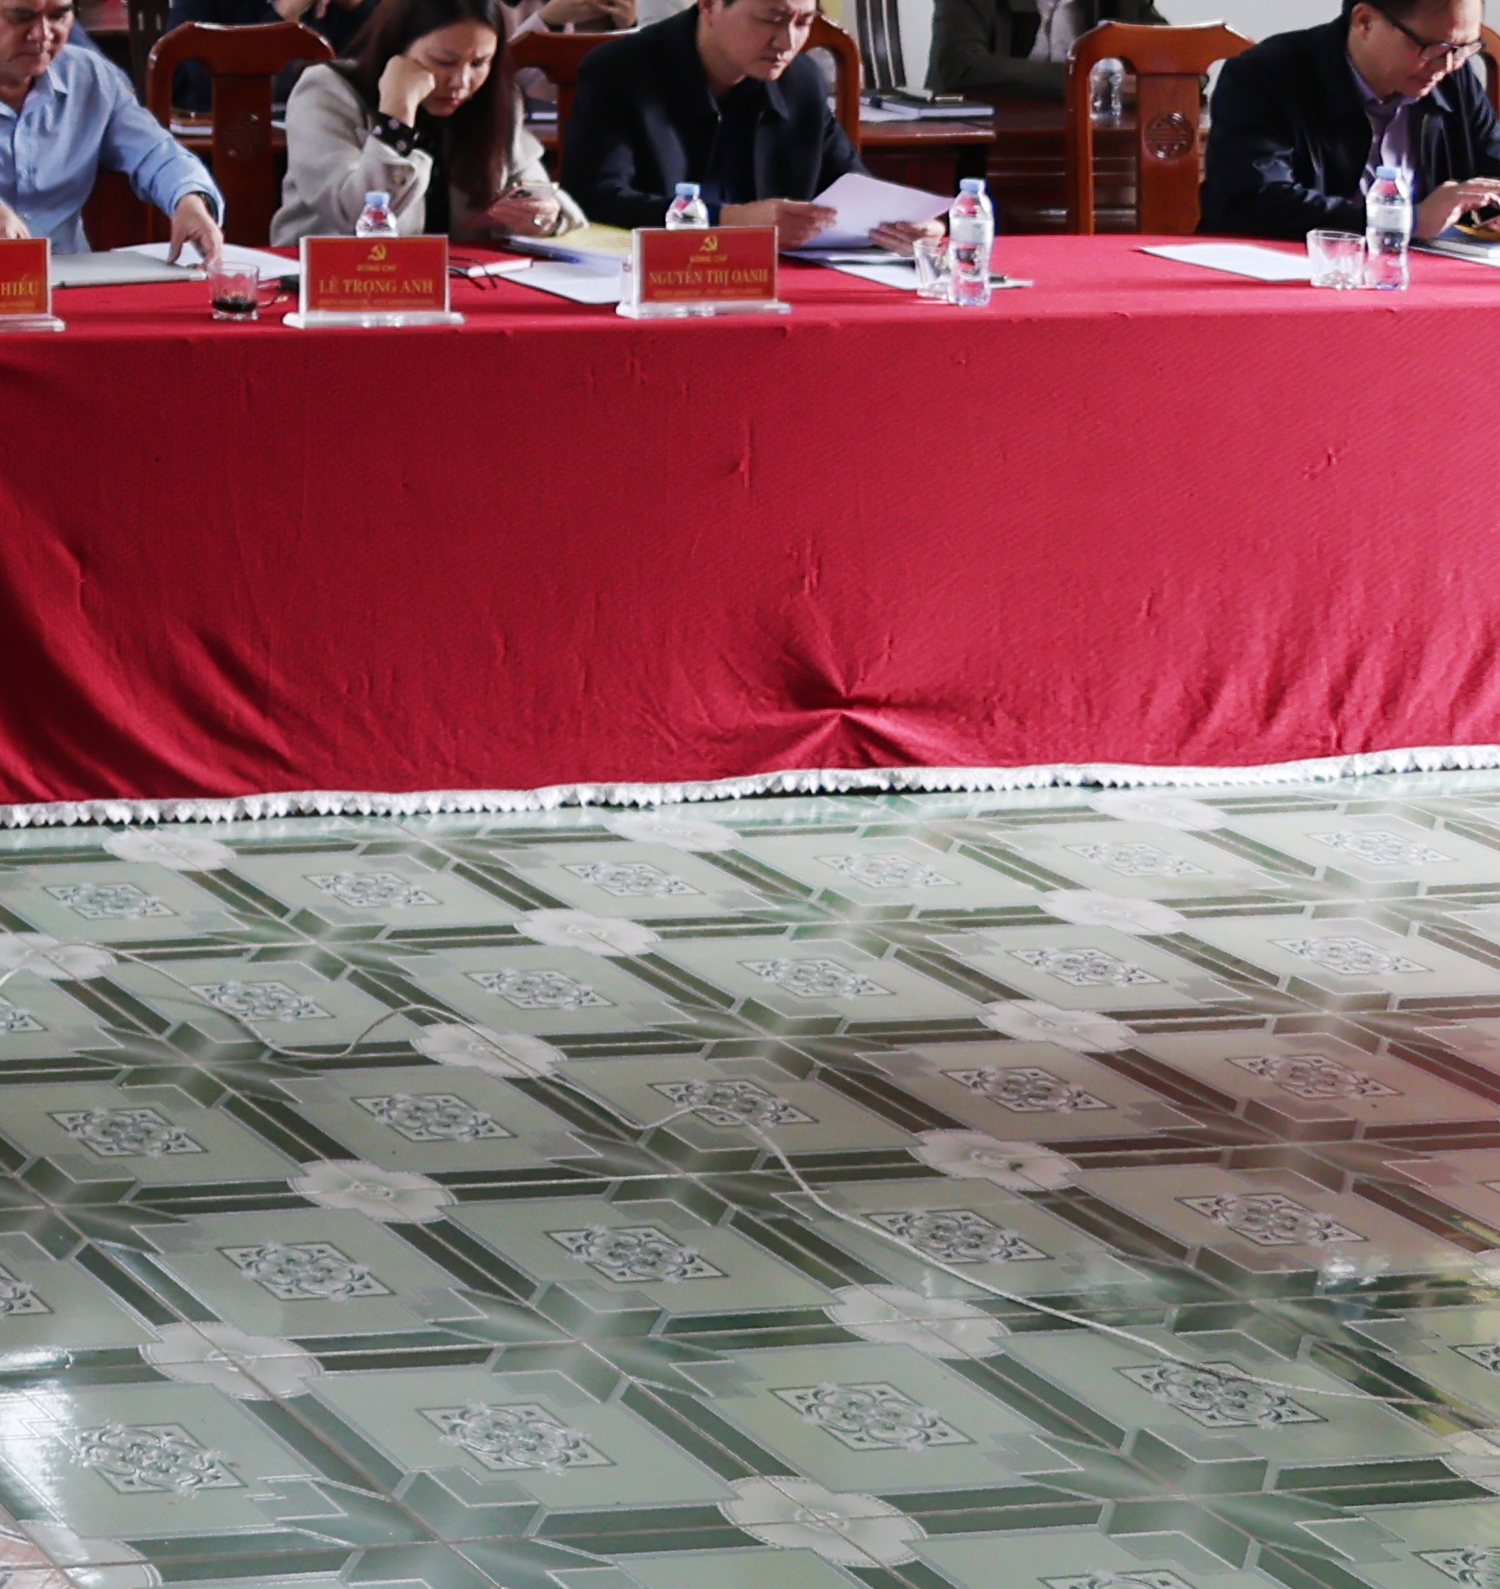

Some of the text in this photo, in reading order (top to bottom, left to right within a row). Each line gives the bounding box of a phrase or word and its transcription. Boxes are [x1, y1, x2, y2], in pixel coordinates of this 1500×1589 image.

[0, 275, 39, 297] HIẾU
[706, 269, 729, 287] THỊ
[731, 268, 768, 284] OANH
[343, 279, 397, 297] TRỌNG
[400, 279, 433, 294] ANH
